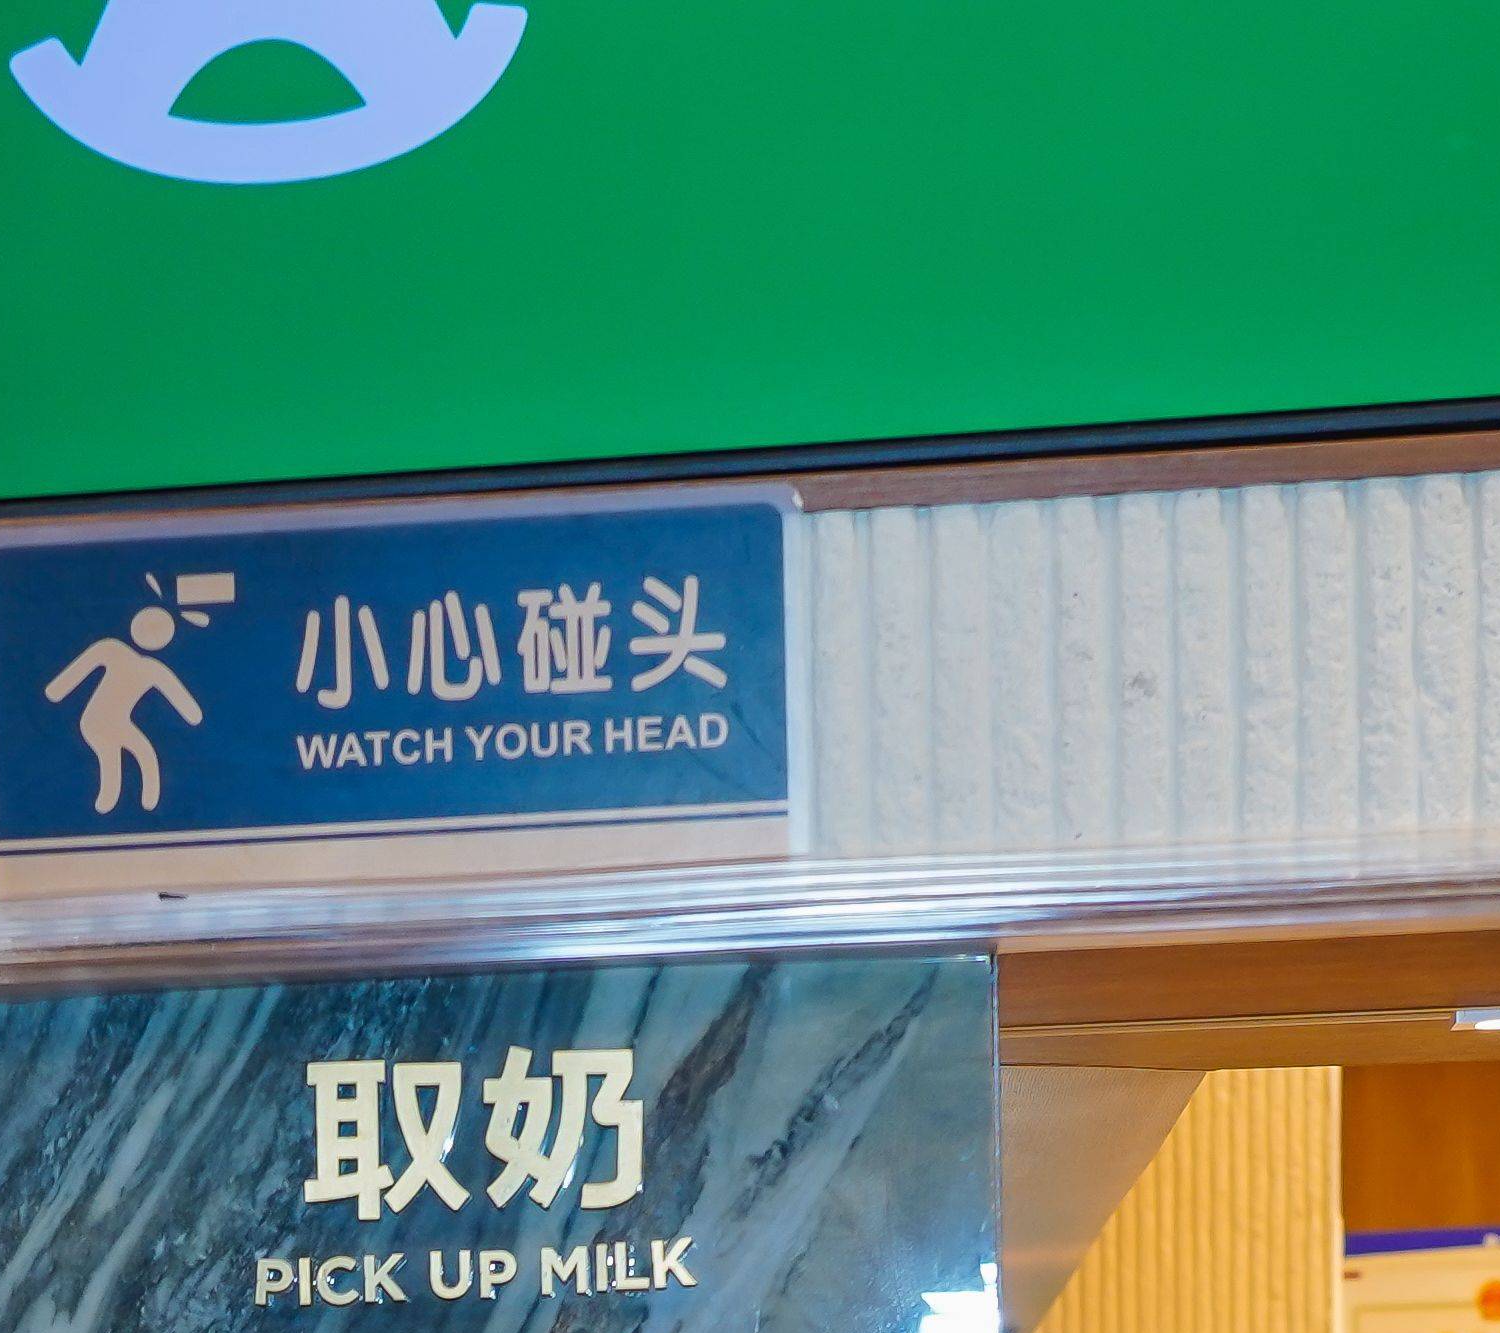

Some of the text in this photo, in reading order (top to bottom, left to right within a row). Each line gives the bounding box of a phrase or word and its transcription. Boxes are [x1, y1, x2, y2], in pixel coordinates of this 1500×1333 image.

[295, 573, 729, 711] 小心碰头
[296, 713, 730, 771] WATCH YOUR HEAD
[303, 1044, 645, 1222] 取奶
[253, 1236, 699, 1308] PICK UP MILK
